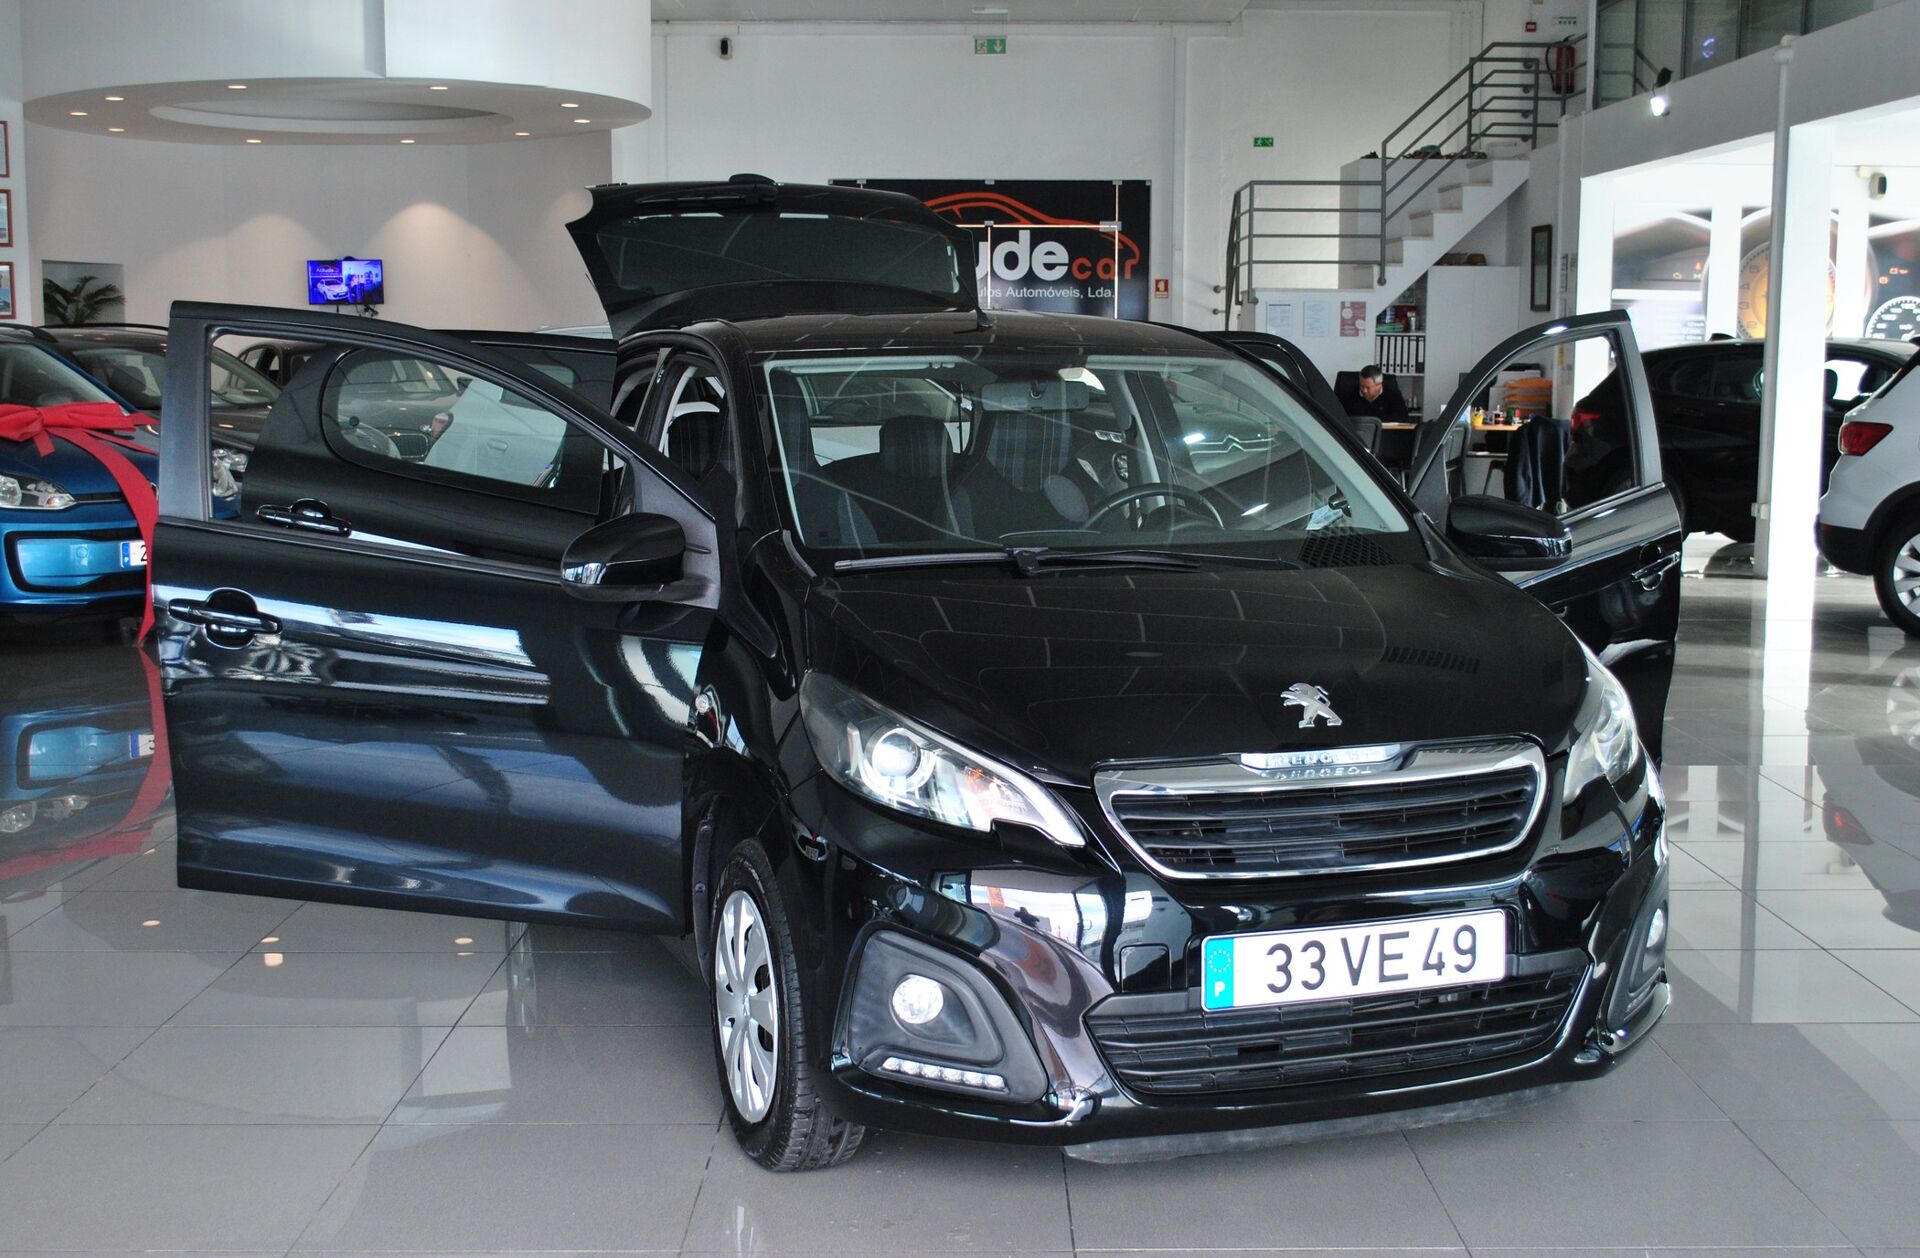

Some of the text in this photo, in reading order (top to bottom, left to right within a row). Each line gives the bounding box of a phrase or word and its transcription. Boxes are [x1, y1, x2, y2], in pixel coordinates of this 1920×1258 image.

[1006, 286, 1084, 299] Automóveis,
[1266, 924, 1477, 994] 33 VE 49
[1214, 980, 1226, 998] P
